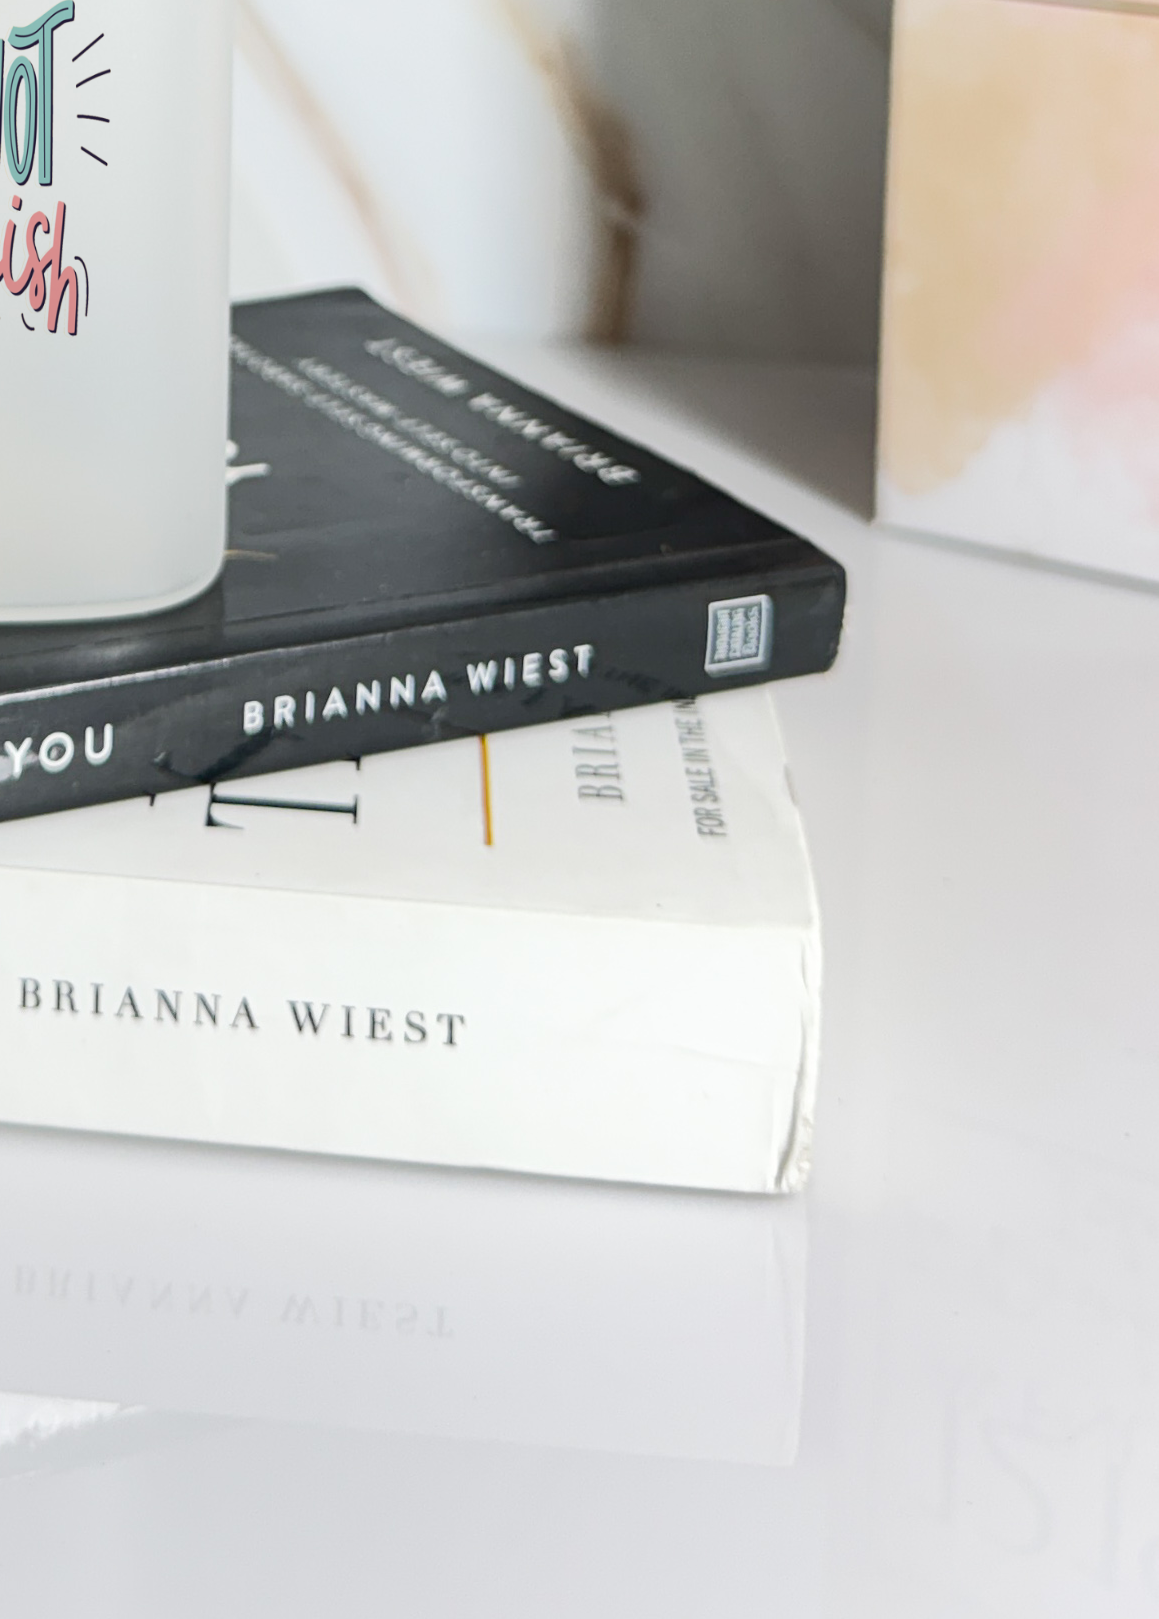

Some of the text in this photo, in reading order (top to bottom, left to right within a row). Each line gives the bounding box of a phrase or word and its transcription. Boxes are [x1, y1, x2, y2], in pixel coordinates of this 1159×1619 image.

[243, 643, 594, 736] BRIANNA WIEST
[3, 723, 114, 780] YOU
[674, 718, 705, 744] THE
[572, 712, 624, 803] BRIA
[682, 748, 710, 762] IN
[685, 768, 719, 803] SALE
[693, 807, 727, 837] FOR
[18, 977, 467, 1047] BRIANNA WIEST
